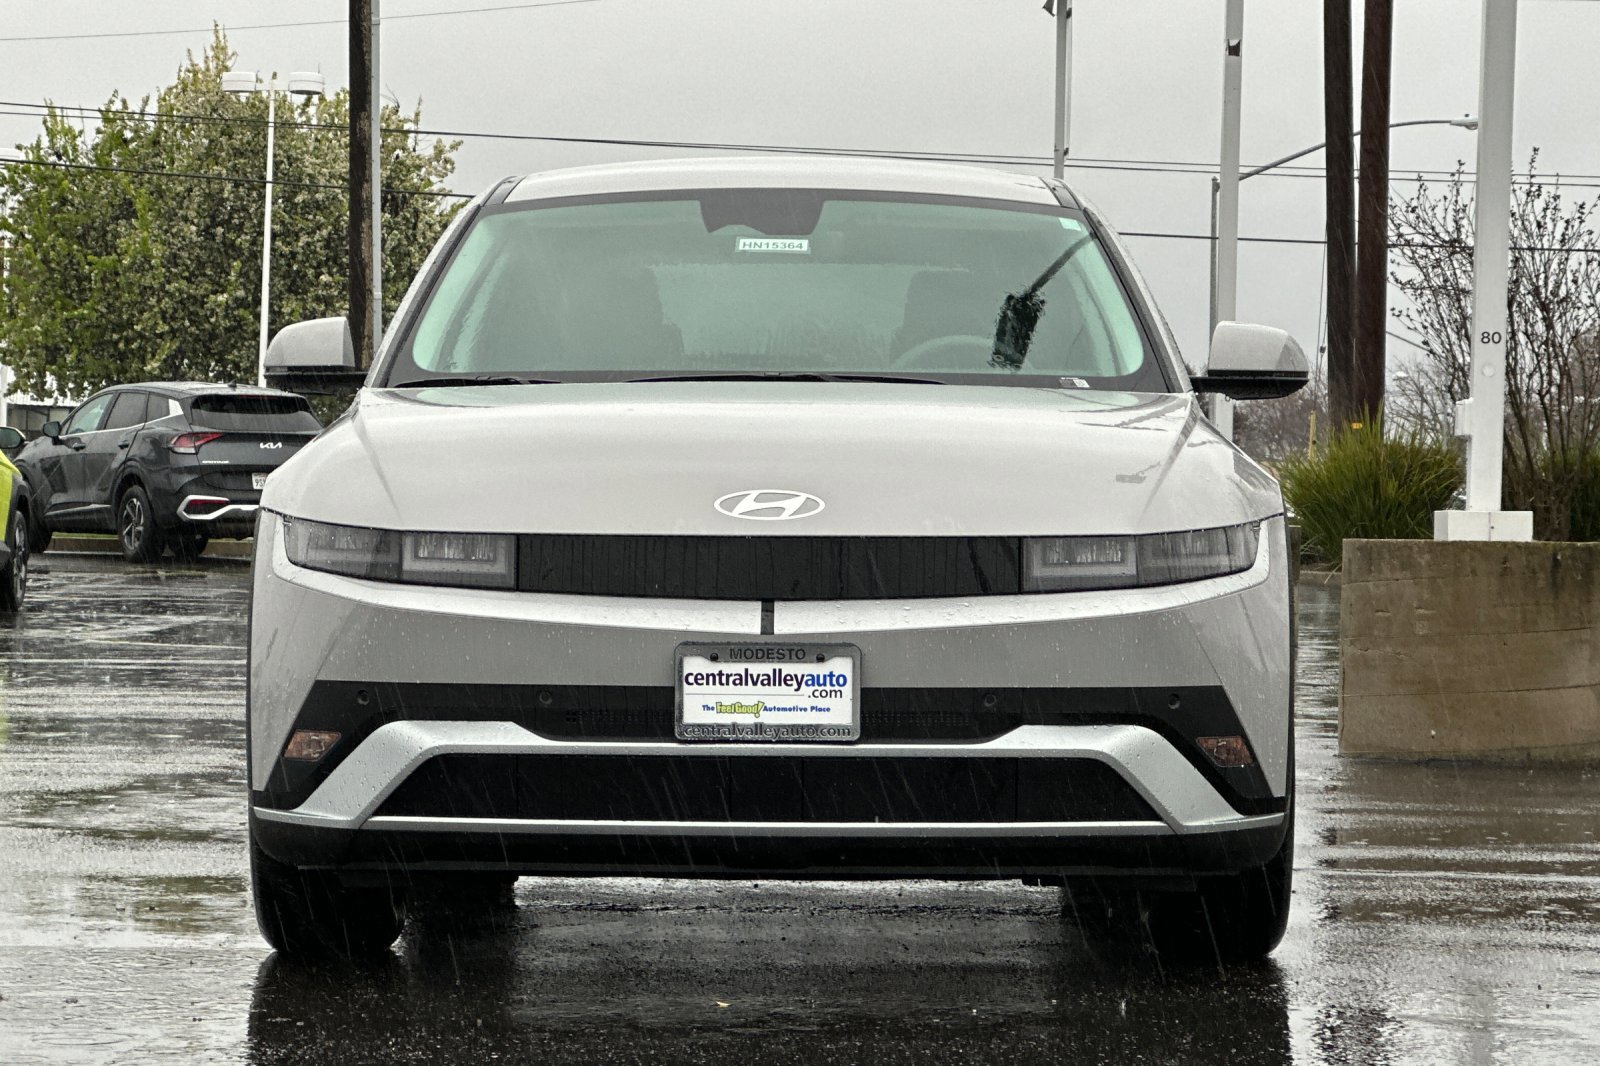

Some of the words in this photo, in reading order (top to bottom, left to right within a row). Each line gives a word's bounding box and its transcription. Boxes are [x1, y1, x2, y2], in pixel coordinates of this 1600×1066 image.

[742, 241, 804, 250] HN15364
[1480, 331, 1502, 344] 80
[729, 648, 806, 661] MODESTO
[808, 688, 843, 699] .com
[702, 704, 715, 712] The
[715, 701, 735, 714] Feel
[683, 722, 851, 741] centralvalleyauto.com
